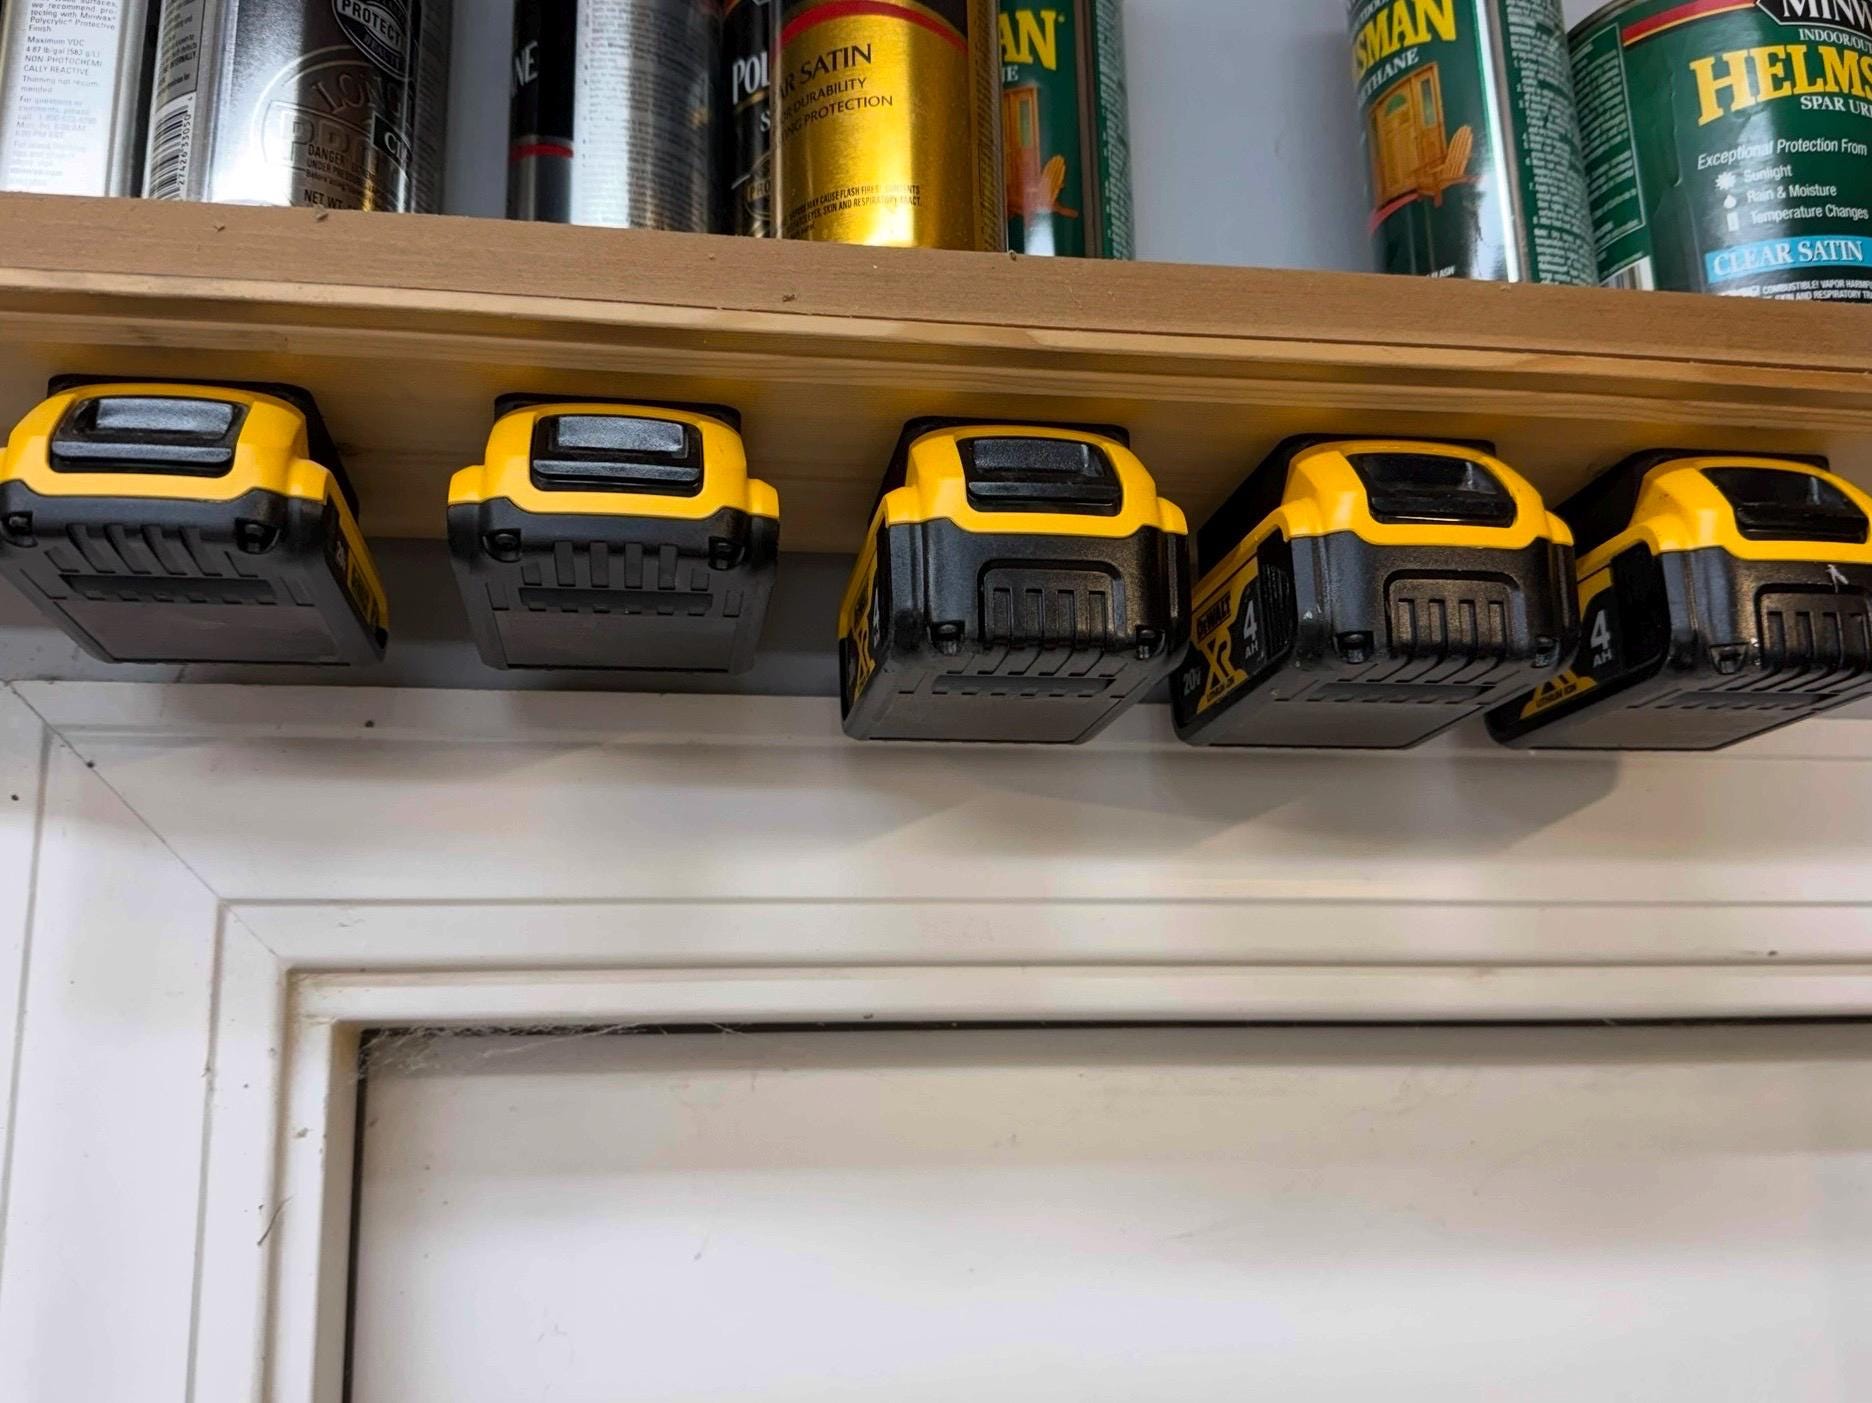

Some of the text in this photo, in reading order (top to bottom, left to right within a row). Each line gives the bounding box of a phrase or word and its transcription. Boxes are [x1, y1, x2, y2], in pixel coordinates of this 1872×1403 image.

[48, 3, 96, 13] recommend
[60, 11, 78, 19] with
[27, 36, 65, 45] Maximum
[24, 65, 89, 76] CALLY REACTIVE
[799, 43, 872, 85] SATIN
[794, 77, 868, 114] DURABILITY
[1800, 95, 1847, 113] SPAR
[804, 95, 894, 126] PROTECTION
[1697, 137, 1868, 170] Exceptional Protection From
[1743, 164, 1793, 184] Sunlight
[304, 188, 324, 205] NET
[820, 192, 840, 205] CAUSE
[840, 187, 860, 199] FLASH
[1746, 184, 1837, 204] Rain & Moisture
[823, 204, 838, 216] SKIN
[838, 200, 852, 211] AND
[1750, 203, 1870, 225] Temperature Changes
[1712, 239, 1864, 277] CLEAR SATIN
[1762, 280, 1820, 295] COMBUSTIBLE!
[1820, 278, 1845, 290] VAPOR
[1813, 289, 1861, 299] RESPIRATORY
[1243, 599, 1257, 640] 4
[1590, 608, 1611, 652] 4
[1592, 649, 1612, 668] AH
